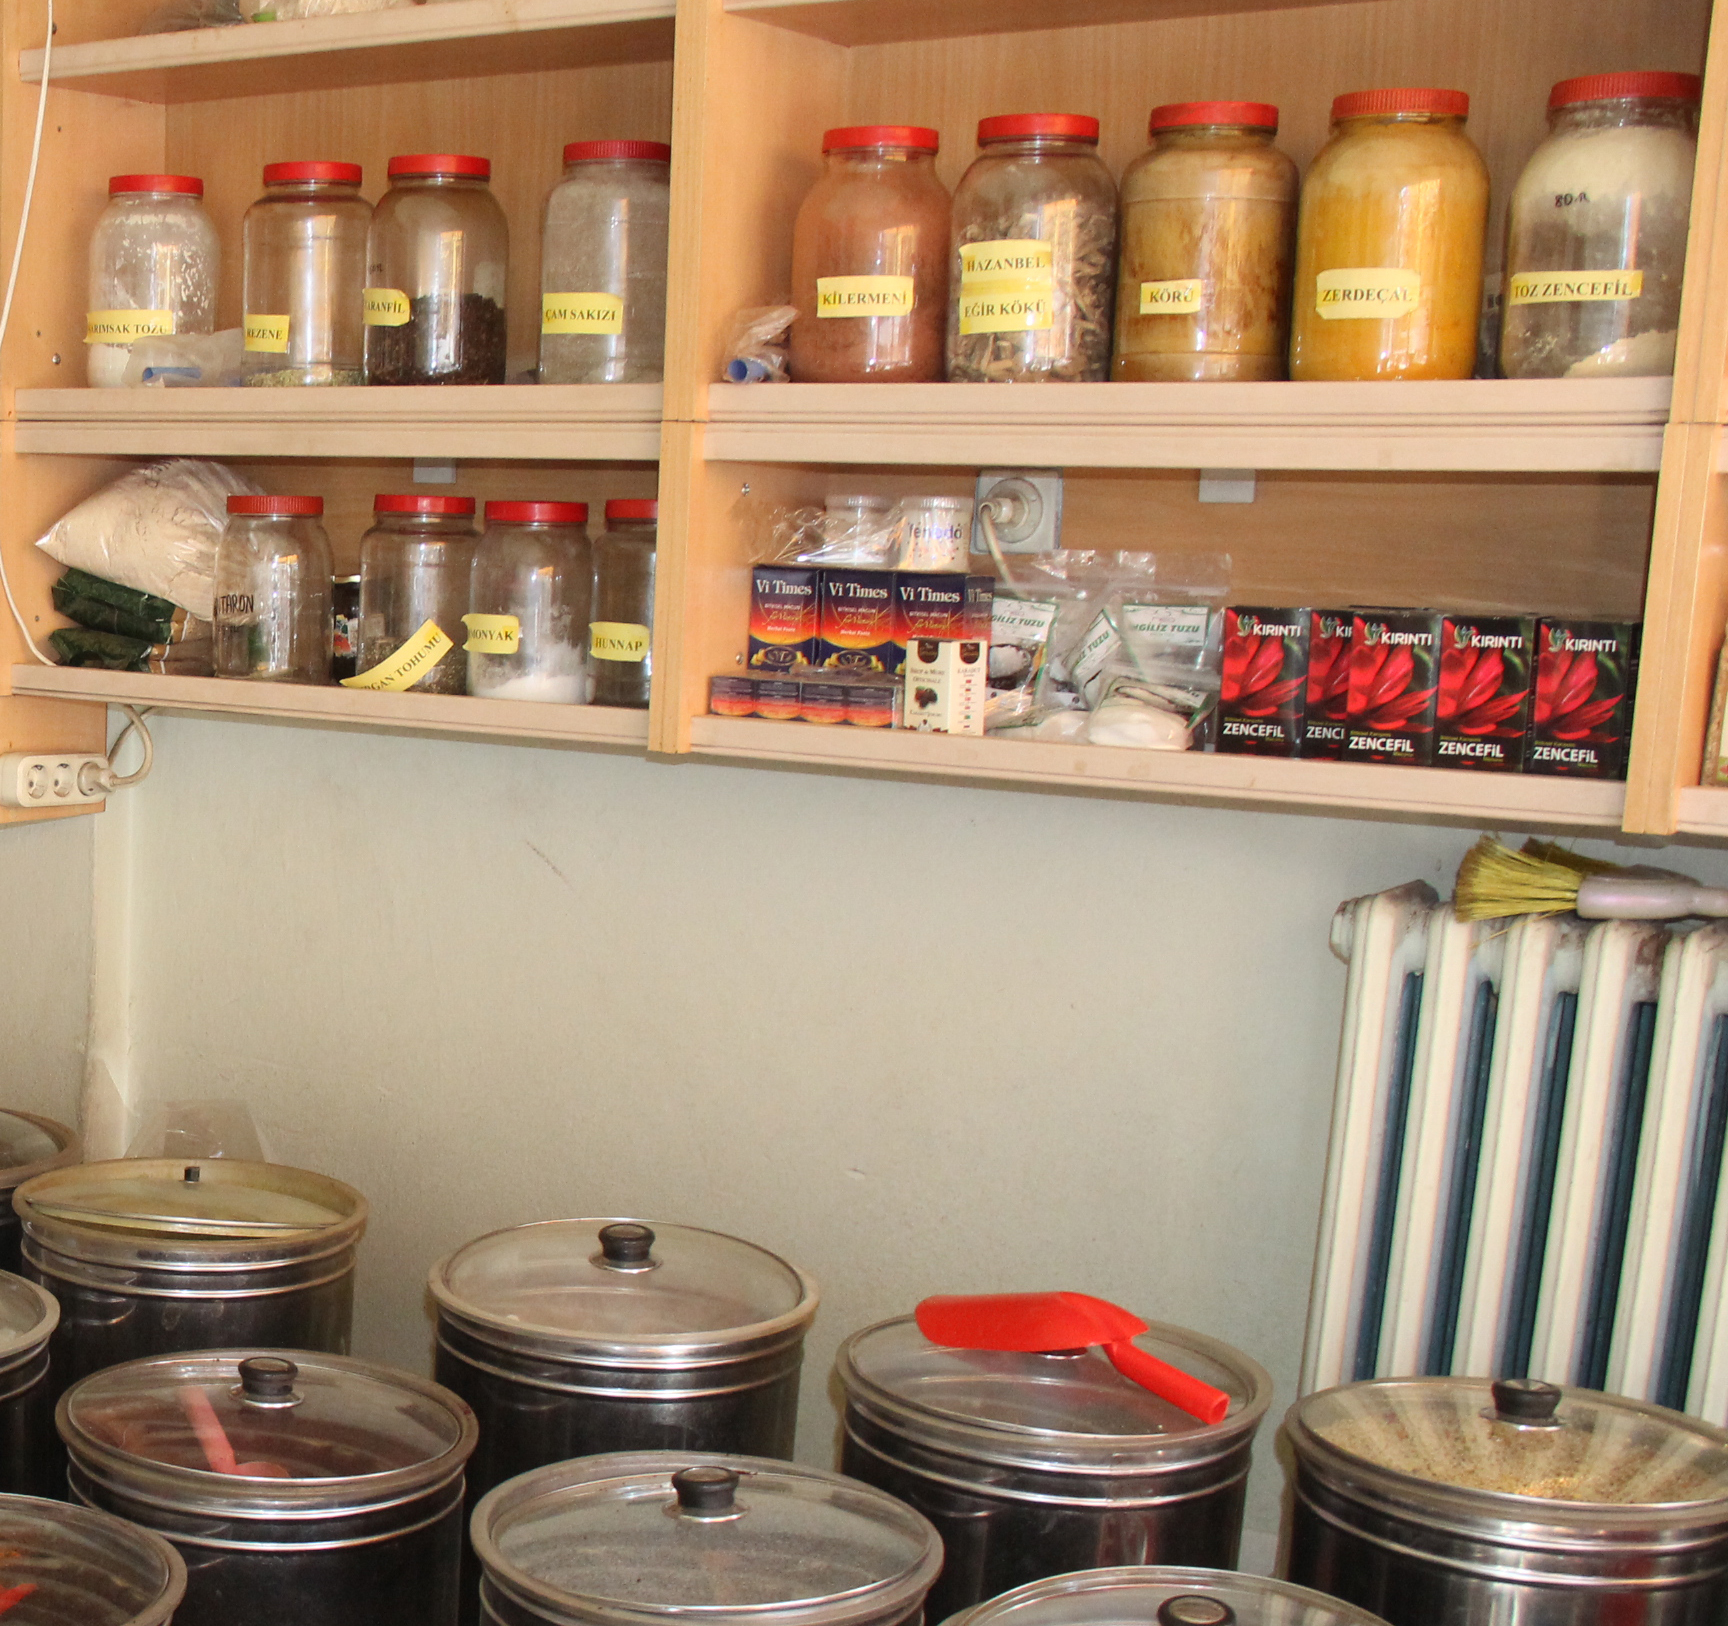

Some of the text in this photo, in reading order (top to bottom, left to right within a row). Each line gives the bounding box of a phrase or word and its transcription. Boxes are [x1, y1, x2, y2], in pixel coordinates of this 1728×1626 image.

[966, 256, 1046, 273] HAZANBEL
[1322, 288, 1413, 305] ZERDEÇAL
[1515, 279, 1634, 299] TOZ ZENCEFİL
[822, 290, 907, 306] KİLERMENİ
[366, 300, 406, 315] ARANFİL
[964, 299, 1046, 318] EĞİR KÖKÜ
[545, 308, 617, 323] ÇAM SAKIZI
[133, 323, 168, 335] TOZU
[247, 328, 283, 341] REZENE
[756, 579, 813, 596] Vi Times
[829, 582, 889, 599] Vi Times
[900, 586, 961, 603] Vi Times
[1019, 618, 1046, 629] TUZU
[1171, 623, 1201, 634] TUZU
[1252, 623, 1301, 637] KIRINTI
[594, 637, 643, 652] HUNNAP
[1087, 629, 1111, 652] TUZU
[1380, 631, 1432, 646] KIRINTI
[1471, 634, 1522, 649] KIRINTI
[1564, 638, 1616, 652] KIRINTI
[395, 632, 443, 678] TOHUMU
